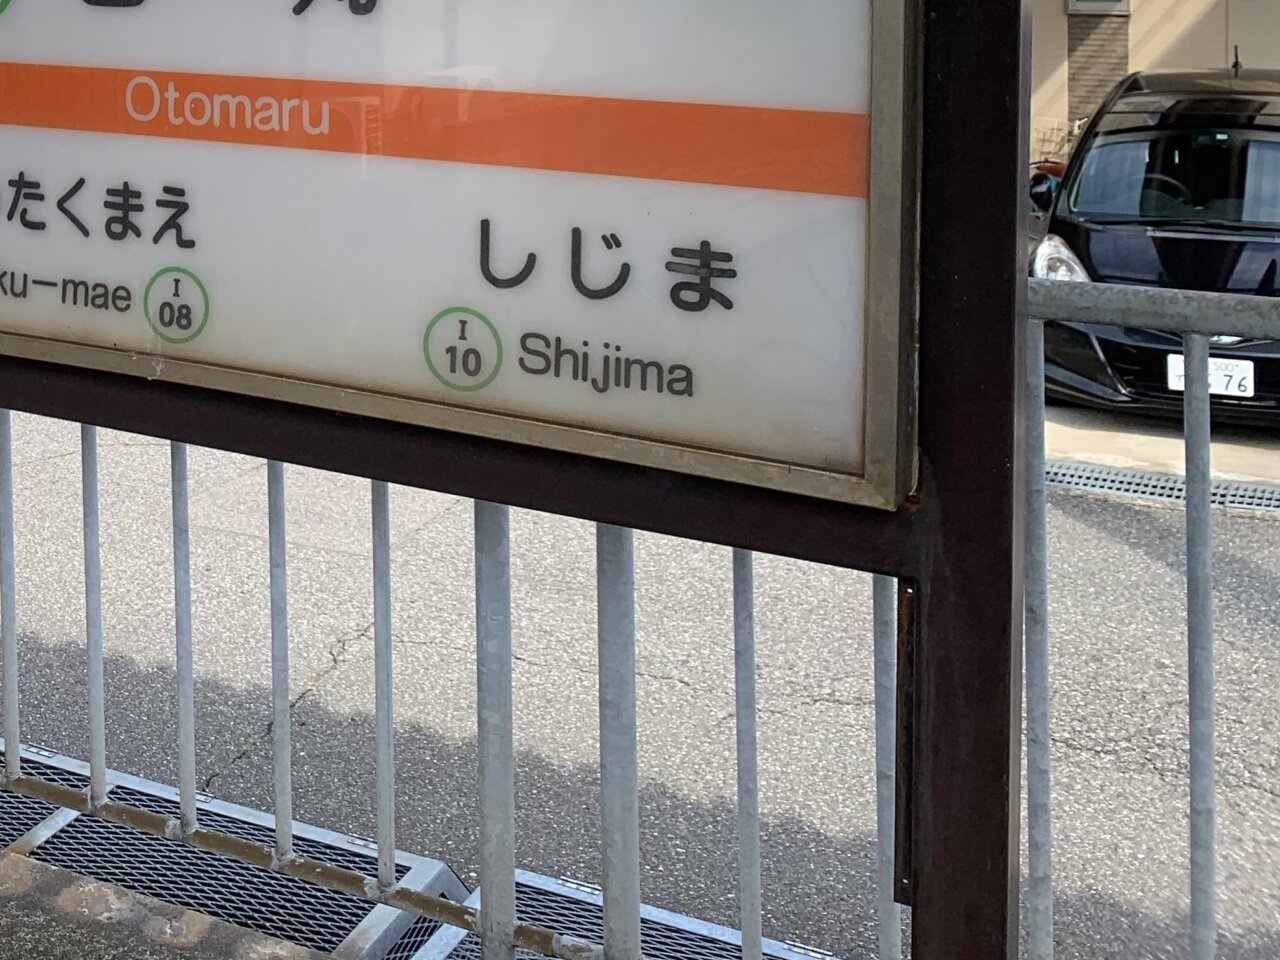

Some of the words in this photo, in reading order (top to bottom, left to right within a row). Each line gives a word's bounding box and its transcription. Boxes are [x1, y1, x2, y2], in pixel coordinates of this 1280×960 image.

[124, 74, 331, 136] Otomaru
[479, 217, 738, 313] しじま
[171, 278, 181, 298] I
[158, 301, 193, 331] 08
[458, 319, 468, 341] I
[444, 344, 482, 377] 10
[518, 331, 695, 398] Shijima
